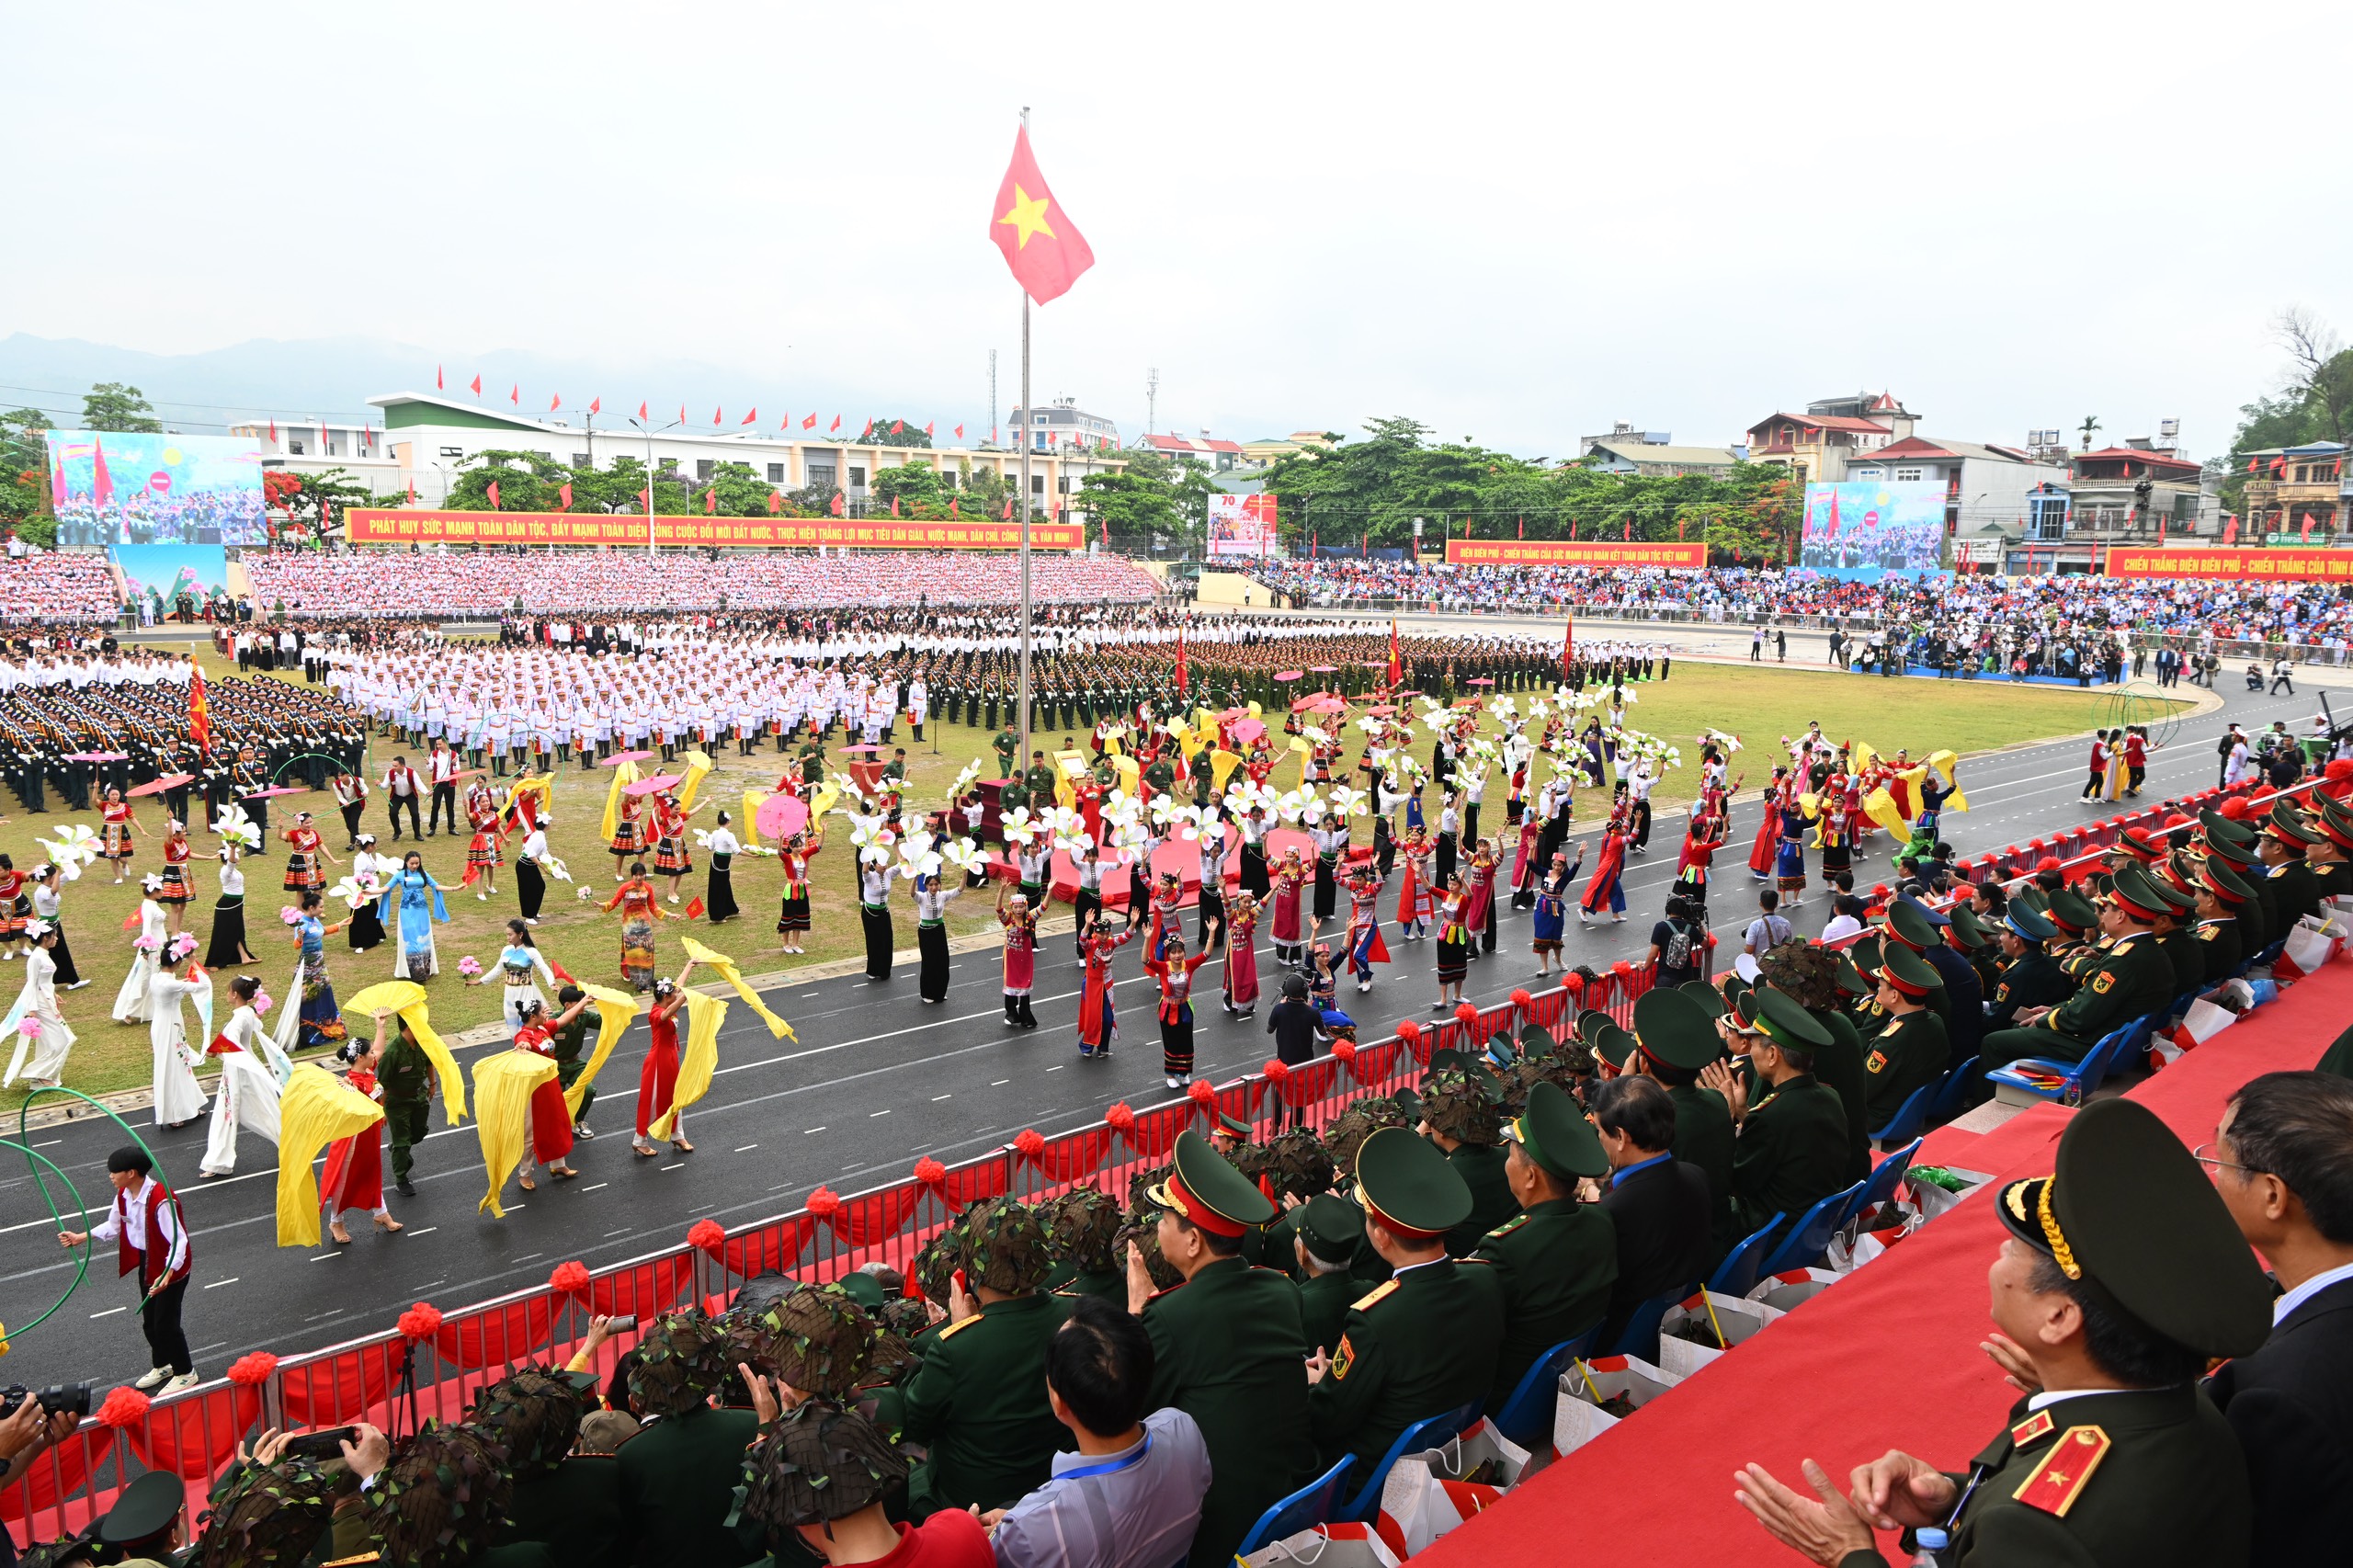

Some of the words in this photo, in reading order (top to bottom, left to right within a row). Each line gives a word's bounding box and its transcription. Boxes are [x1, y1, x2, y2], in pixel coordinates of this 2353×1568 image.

[1222, 495, 1236, 506] 70
[369, 517, 395, 534] PHÁT
[399, 520, 419, 534] HUY
[422, 517, 442, 535] SỨC
[446, 521, 475, 538] MẠNH
[478, 519, 503, 535] TOÀN
[506, 520, 526, 536] DÂN
[528, 520, 549, 539] TỘC,
[551, 518, 569, 536] ĐẨY
[573, 523, 599, 539] MẠNH
[602, 521, 624, 537] TOÀN
[627, 522, 648, 540] DIỆN
[676, 523, 697, 541] CUỘC
[700, 522, 714, 539] ĐỔI
[716, 523, 731, 539] MỚI
[733, 523, 748, 540] ĐẤT
[750, 525, 774, 540] NƯỚC,
[777, 527, 796, 542] THỰC
[799, 525, 816, 542] HIỆN
[818, 524, 842, 540] THẮNG
[845, 528, 855, 542] LỢI
[858, 528, 874, 543] MỤC
[875, 527, 891, 540] TIÊU
[892, 528, 906, 541] DÂN
[908, 529, 926, 542] GIÀU,
[928, 528, 945, 541] NƯỚC
[947, 529, 969, 544] MẠNH,
[970, 529, 983, 542] DÂN
[986, 527, 1000, 543] CHỦ,
[1001, 529, 1018, 542] CÔNG
[1040, 530, 1052, 543] VĂN
[1460, 546, 1473, 559] ĐIỆN
[1474, 546, 1487, 558] BIÊN
[1489, 545, 1500, 558] PHỦ
[1504, 546, 1520, 558] CHIẾN
[1522, 546, 1539, 559] THẮNG
[1540, 547, 1552, 559] CỦA
[1553, 548, 1564, 560] SỨC
[1565, 550, 1581, 562] MẠNH
[1583, 551, 1592, 562] ĐẠI
[1594, 549, 1608, 561] ĐOÀN
[1610, 548, 1621, 561] KẾT
[1622, 550, 1637, 561] TOÀN
[1638, 549, 1649, 561] DÂN
[1651, 550, 1661, 563] TỘC
[1663, 550, 1674, 563] VIỆT
[1675, 551, 1691, 561] NAM!
[2124, 555, 2149, 571] CHIẾN
[2150, 554, 2177, 572] THẮNG
[2179, 557, 2199, 574] ĐIỆN
[2201, 557, 2221, 572] BIÊN
[2223, 555, 2241, 572] PHỦ
[2248, 556, 2275, 573] CHIẾN
[2277, 555, 2306, 574] THẮNG
[2308, 556, 2325, 574] CỦA
